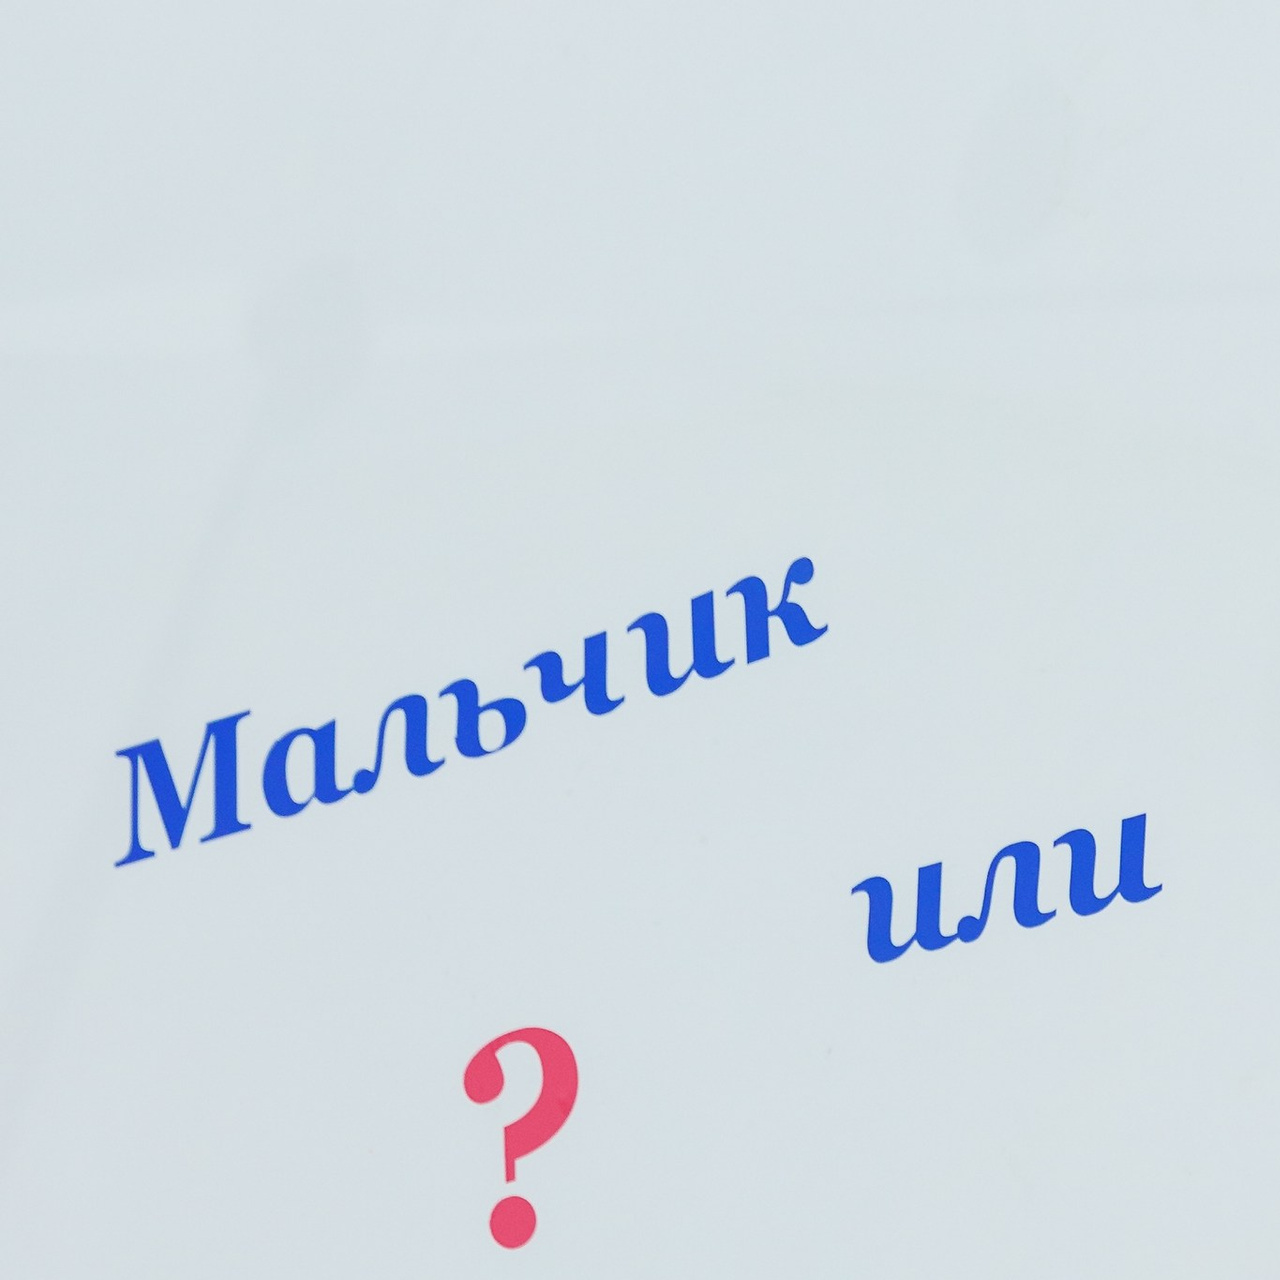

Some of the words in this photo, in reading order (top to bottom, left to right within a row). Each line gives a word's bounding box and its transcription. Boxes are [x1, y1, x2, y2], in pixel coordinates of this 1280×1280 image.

[114, 556, 828, 868] Мальчик
[851, 812, 1162, 964] или
[463, 1027, 578, 1249] ?
